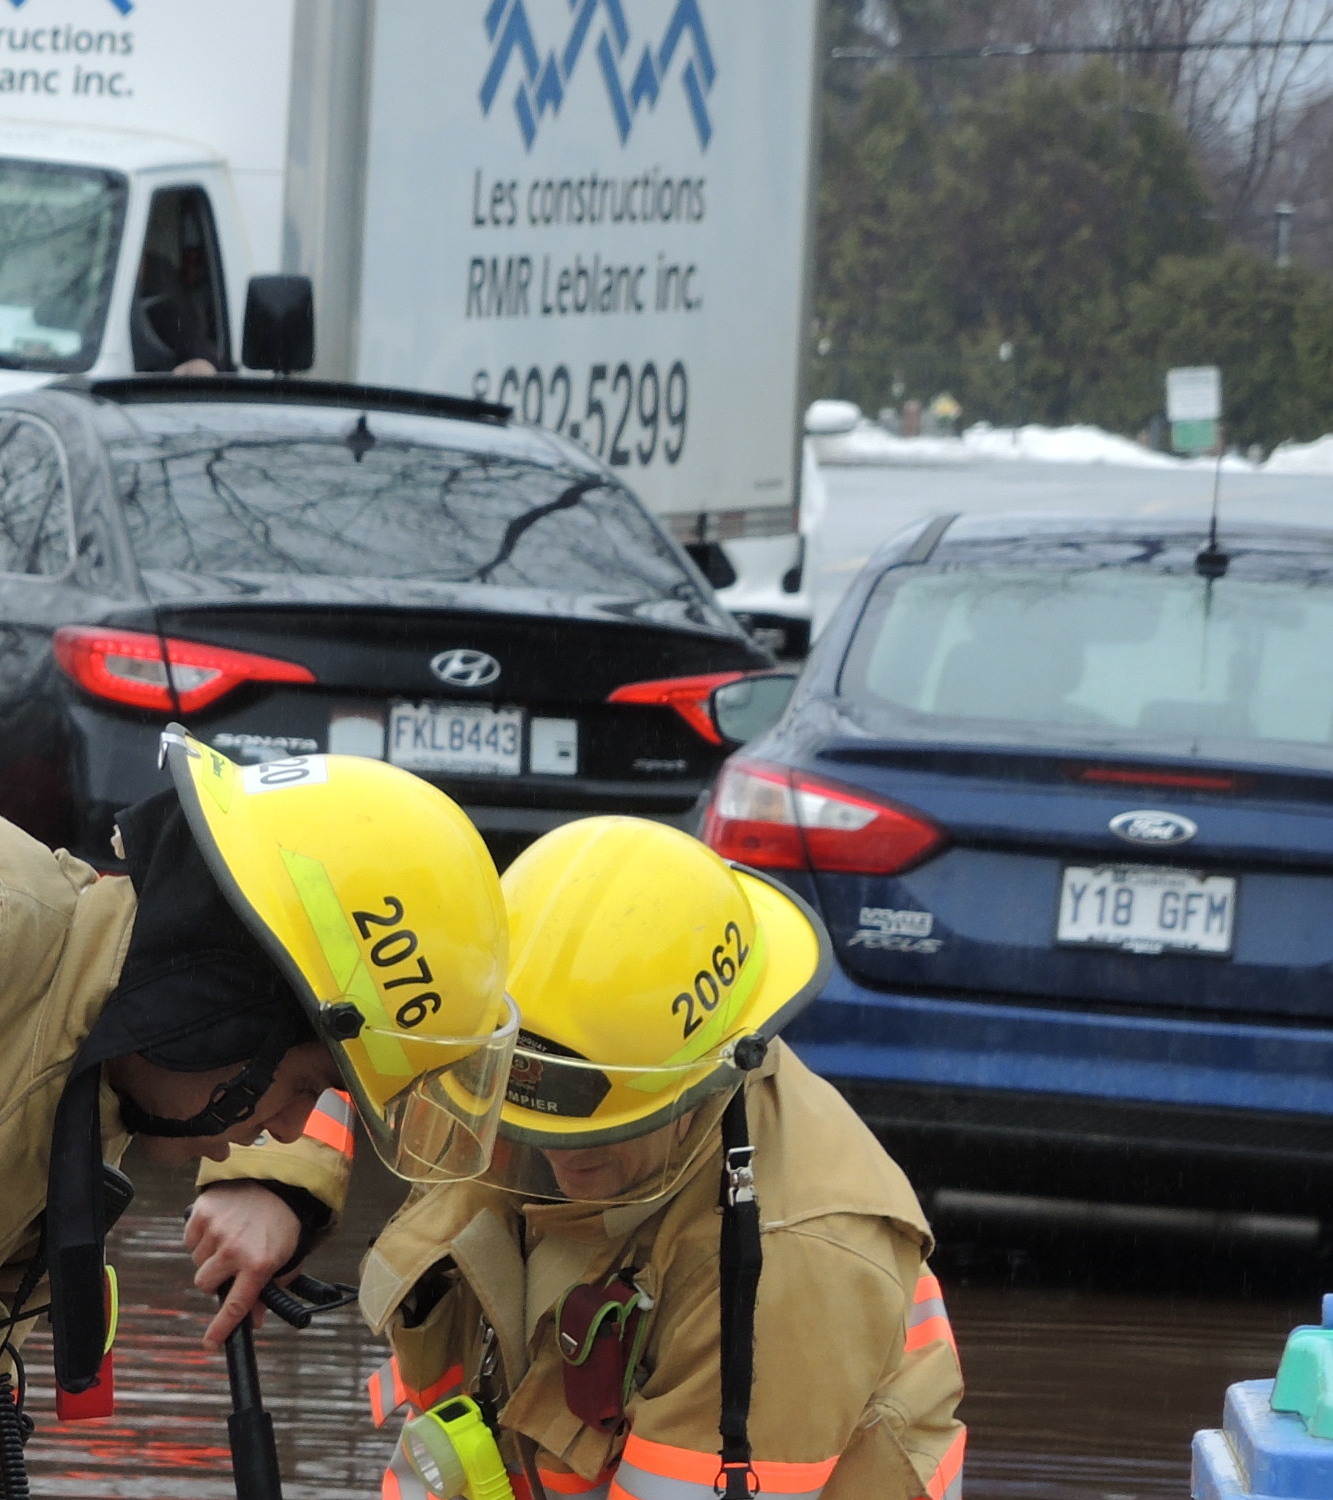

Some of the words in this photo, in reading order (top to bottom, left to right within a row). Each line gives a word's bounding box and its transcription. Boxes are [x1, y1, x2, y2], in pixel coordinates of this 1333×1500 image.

[73, 65, 134, 97] inc.
[473, 168, 517, 226] Les
[528, 164, 707, 225] constructions
[466, 255, 532, 318] RMR
[541, 252, 645, 315] Leblanc
[654, 251, 703, 313] inc.
[396, 715, 518, 756] FKL8443
[1069, 882, 1135, 926] Y18
[1159, 890, 1228, 935] GFM
[351, 895, 442, 1030] 2076
[671, 920, 750, 1040] 2062
